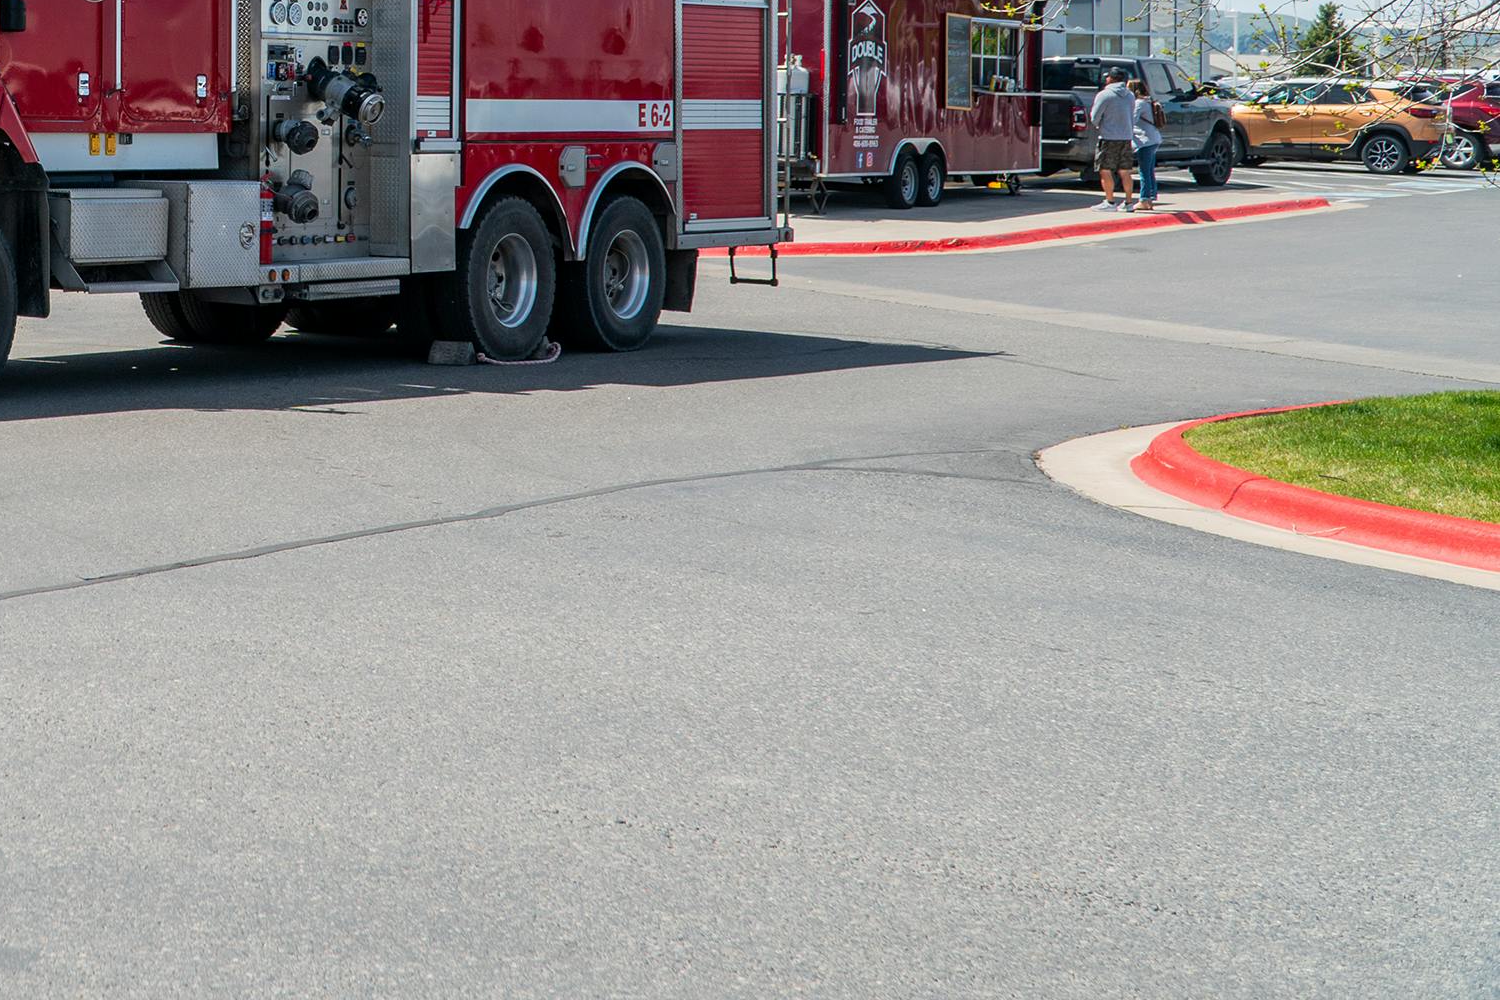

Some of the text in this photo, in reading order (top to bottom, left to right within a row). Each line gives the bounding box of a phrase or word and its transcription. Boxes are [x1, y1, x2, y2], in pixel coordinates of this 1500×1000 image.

[851, 41, 883, 64] DOUBLE
[638, 103, 671, 127] E 6-2
